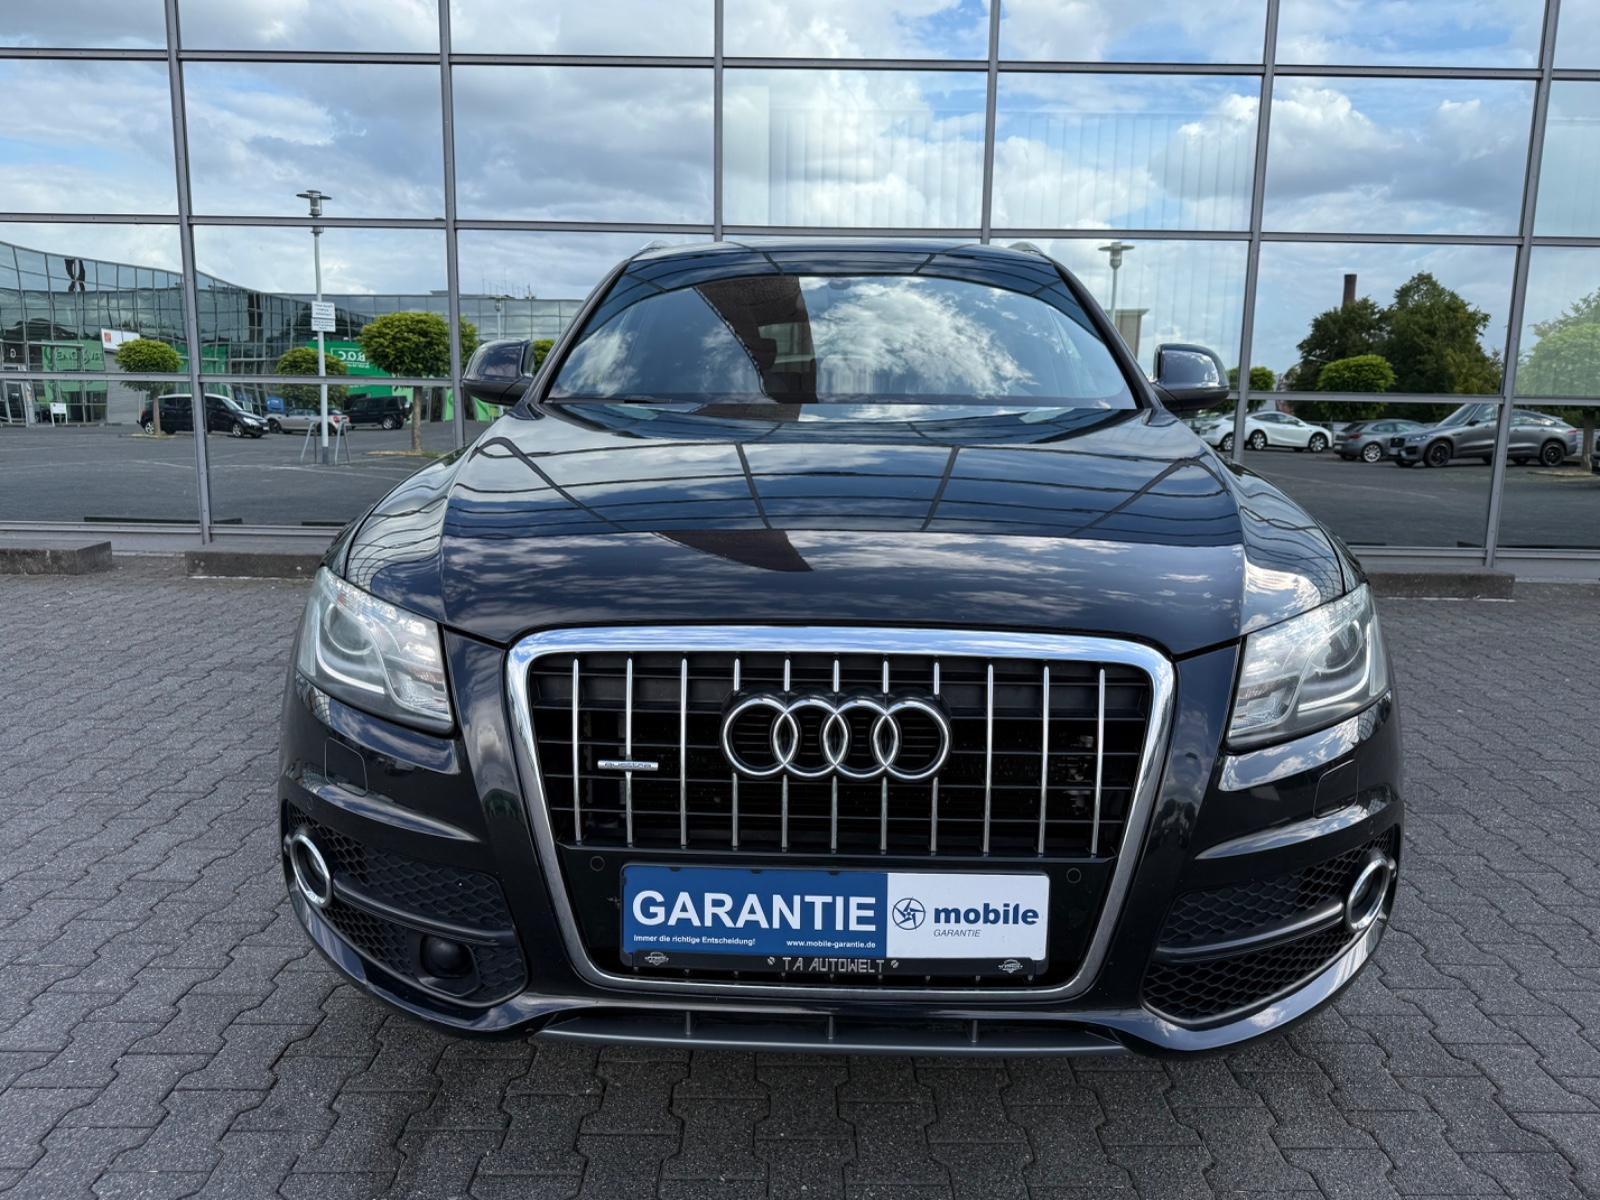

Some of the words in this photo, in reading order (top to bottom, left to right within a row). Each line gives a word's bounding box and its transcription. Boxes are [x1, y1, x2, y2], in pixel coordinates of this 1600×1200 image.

[632, 890, 876, 931] GARANTIE
[934, 902, 1040, 926] mobile
[933, 928, 982, 938] GARANTIE
[633, 934, 658, 943] Immer
[659, 934, 671, 943] die
[672, 935, 701, 945] richtige
[702, 936, 756, 947] Entscheidung!
[786, 940, 876, 949] www.mobile-garantie.de
[808, 958, 885, 974] AUTOWELT
